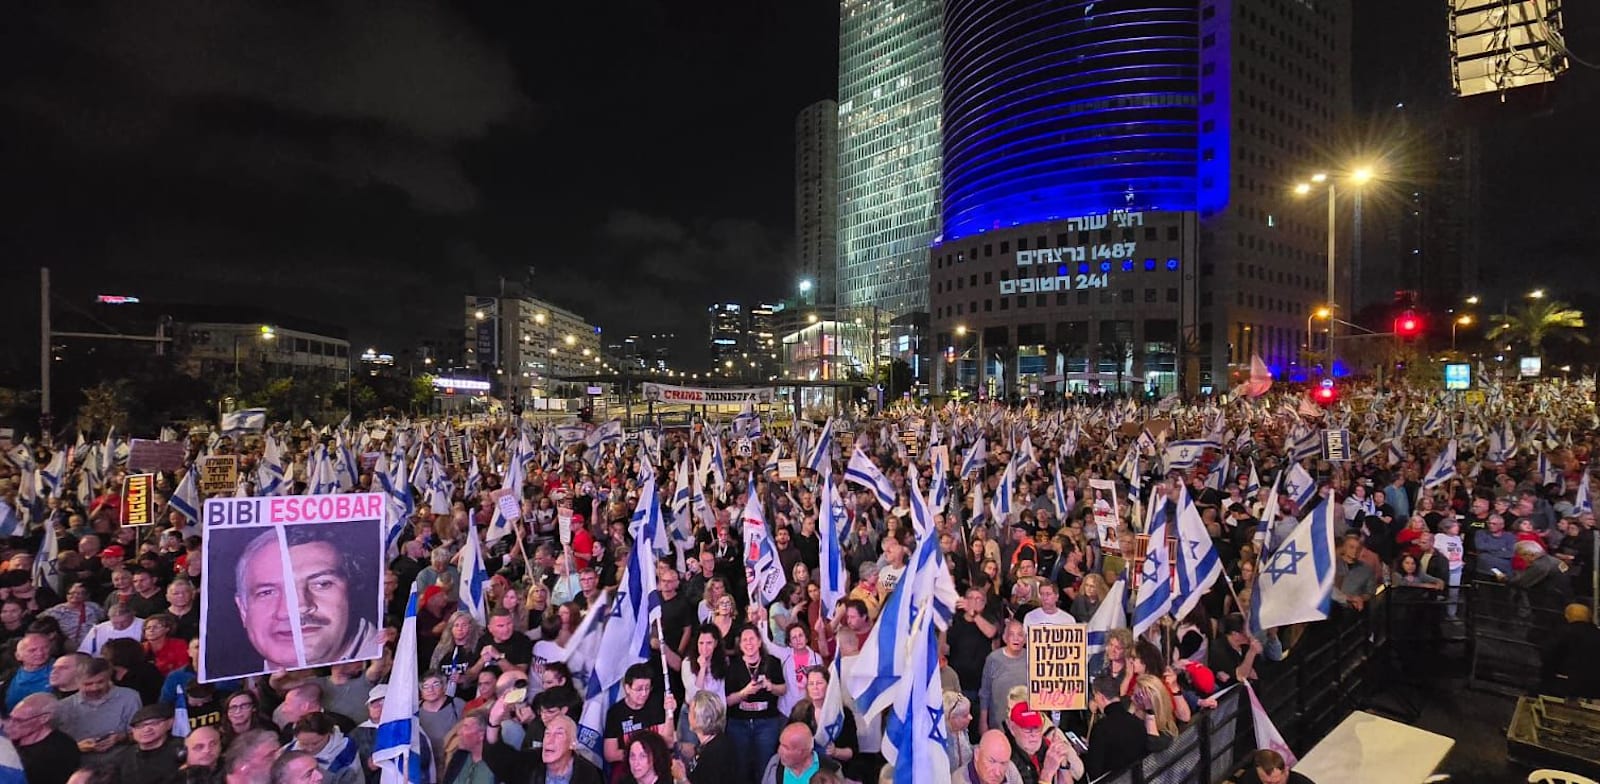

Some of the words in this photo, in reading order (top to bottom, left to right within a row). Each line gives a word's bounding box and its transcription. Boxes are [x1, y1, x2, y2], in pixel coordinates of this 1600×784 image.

[1067, 214, 1107, 232] שנה
[1113, 209, 1143, 228] חצי
[1016, 246, 1086, 266] נרצחים
[1092, 242, 1137, 260] 1487
[1000, 275, 1071, 294] חטופים
[1076, 273, 1108, 290] 241
[664, 390, 703, 401] CRIME
[705, 391, 756, 402] MINISTER
[208, 500, 261, 526] BIBI
[270, 495, 382, 523] ESCOBAR
[1032, 627, 1083, 643] ממשלת
[1036, 644, 1080, 661] כישלון
[1036, 661, 1080, 677] מוחלט
[1031, 678, 1084, 694] מחליפים
